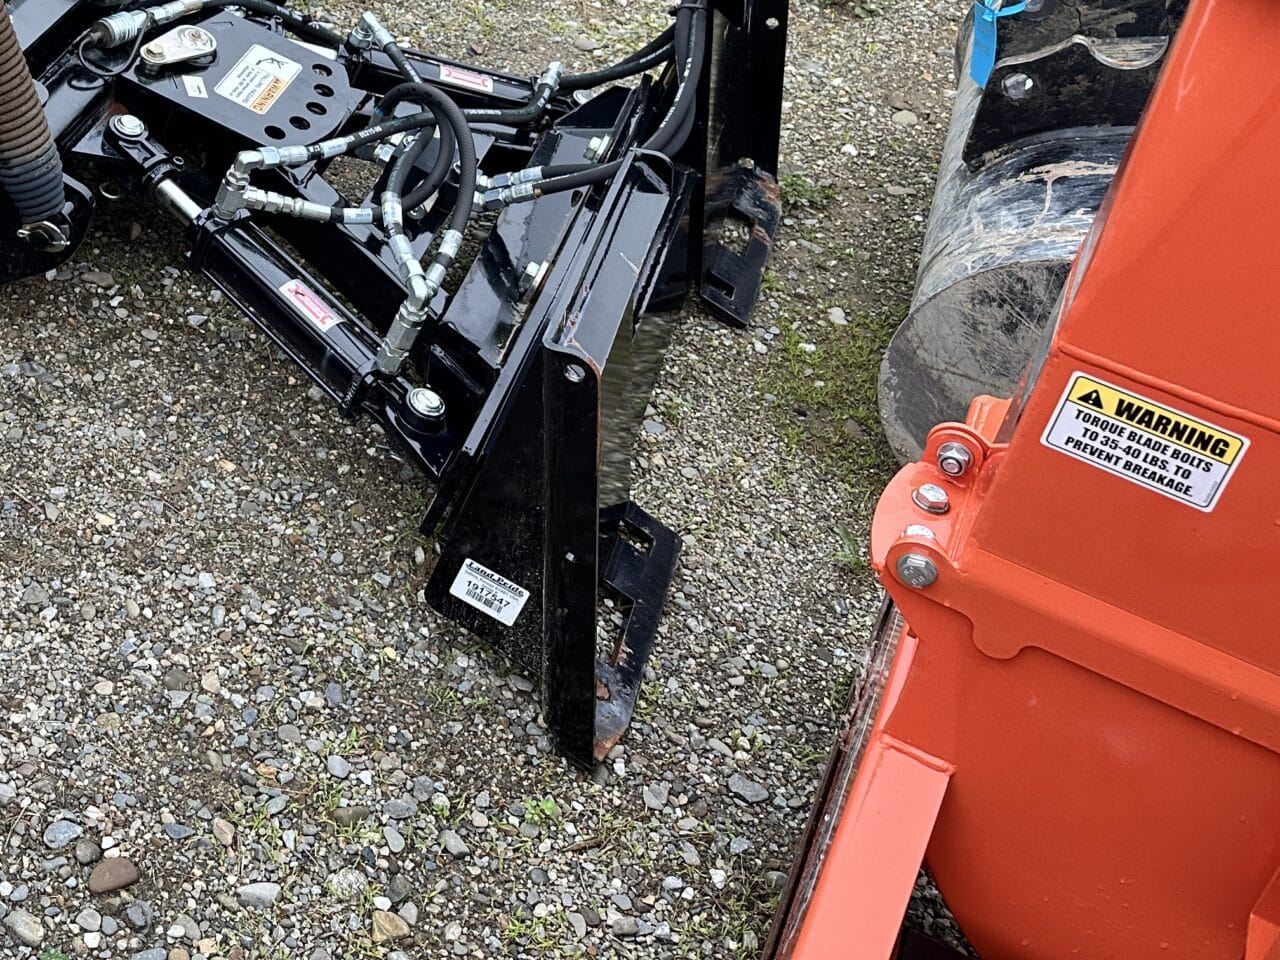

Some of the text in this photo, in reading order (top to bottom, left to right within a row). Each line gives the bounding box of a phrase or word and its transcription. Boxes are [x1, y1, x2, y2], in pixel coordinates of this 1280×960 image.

[253, 83, 281, 112] WARNING
[1074, 408, 1213, 474] TORQUE BLADE BOLTS
[1081, 427, 1192, 480] TO 35-40 LBS. TO
[1114, 398, 1231, 459] WARNING
[1064, 436, 1123, 467] PREVENT
[1122, 459, 1194, 498] BREAKAGE.
[466, 580, 511, 608] 1917547
[468, 561, 524, 598] Land Pride
